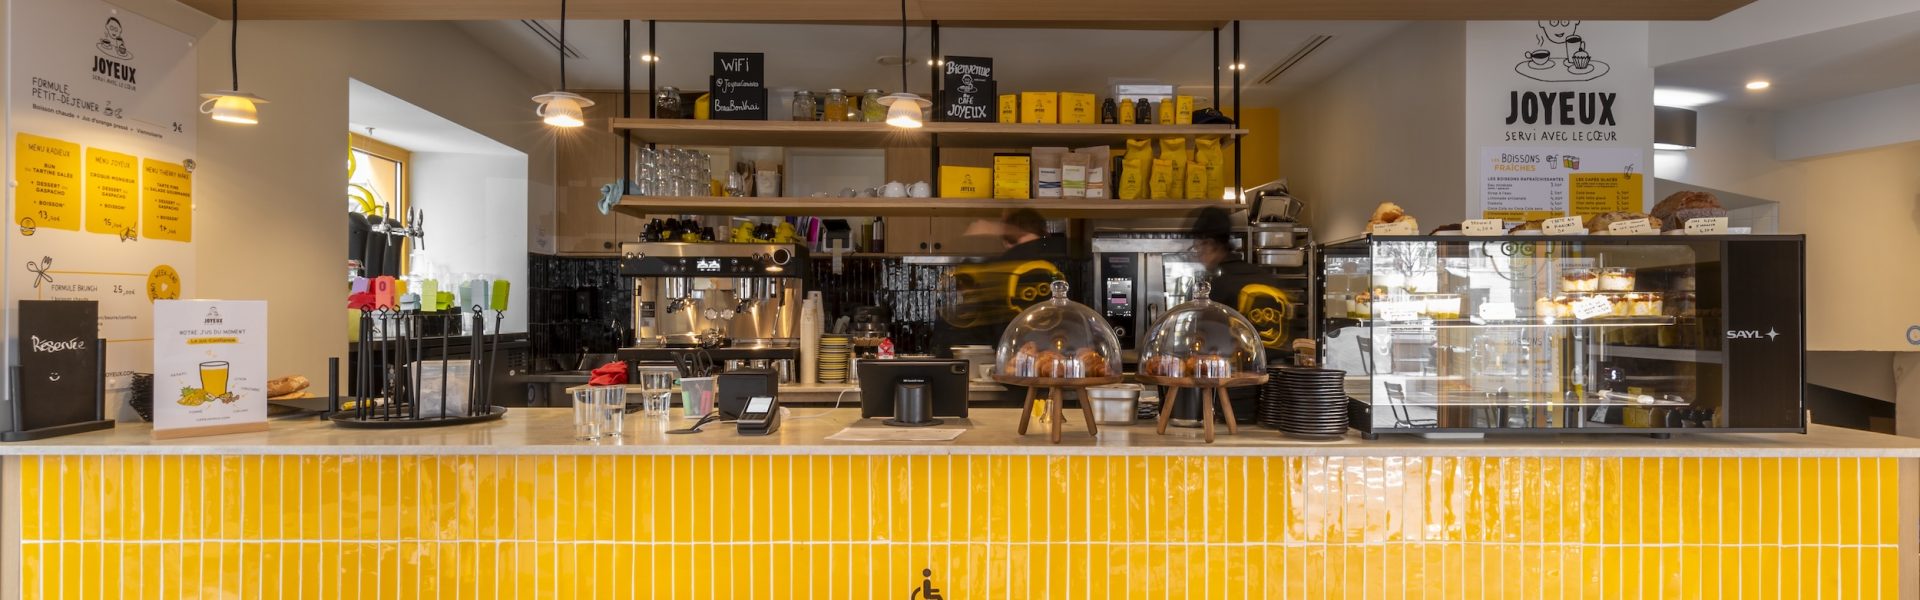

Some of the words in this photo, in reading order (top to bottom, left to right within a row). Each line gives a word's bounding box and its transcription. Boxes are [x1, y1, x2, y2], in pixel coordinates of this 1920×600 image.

[92, 55, 136, 84] JOYEUX
[720, 57, 749, 72] WiFi
[946, 60, 990, 77] Bienvenue
[32, 76, 70, 94] FORMULE
[107, 78, 118, 87] AVEC
[32, 104, 54, 112] Boisson
[56, 109, 75, 118] chaude
[947, 104, 987, 119] JOYEUX
[1505, 90, 1616, 126] JOYEUX
[172, 121, 183, 133] 9€
[1541, 131, 1568, 141] AVEC
[1572, 131, 1583, 141] LE
[1586, 130, 1617, 141] CŒUR
[28, 144, 46, 152] MENU
[96, 156, 109, 164] MENU
[110, 160, 130, 168] JOYEUX
[1494, 163, 1536, 172] FRAÎCHES
[33, 168, 55, 176] TARTINE
[36, 188, 65, 196] GASPACHO
[1726, 330, 1764, 338] SAYL
